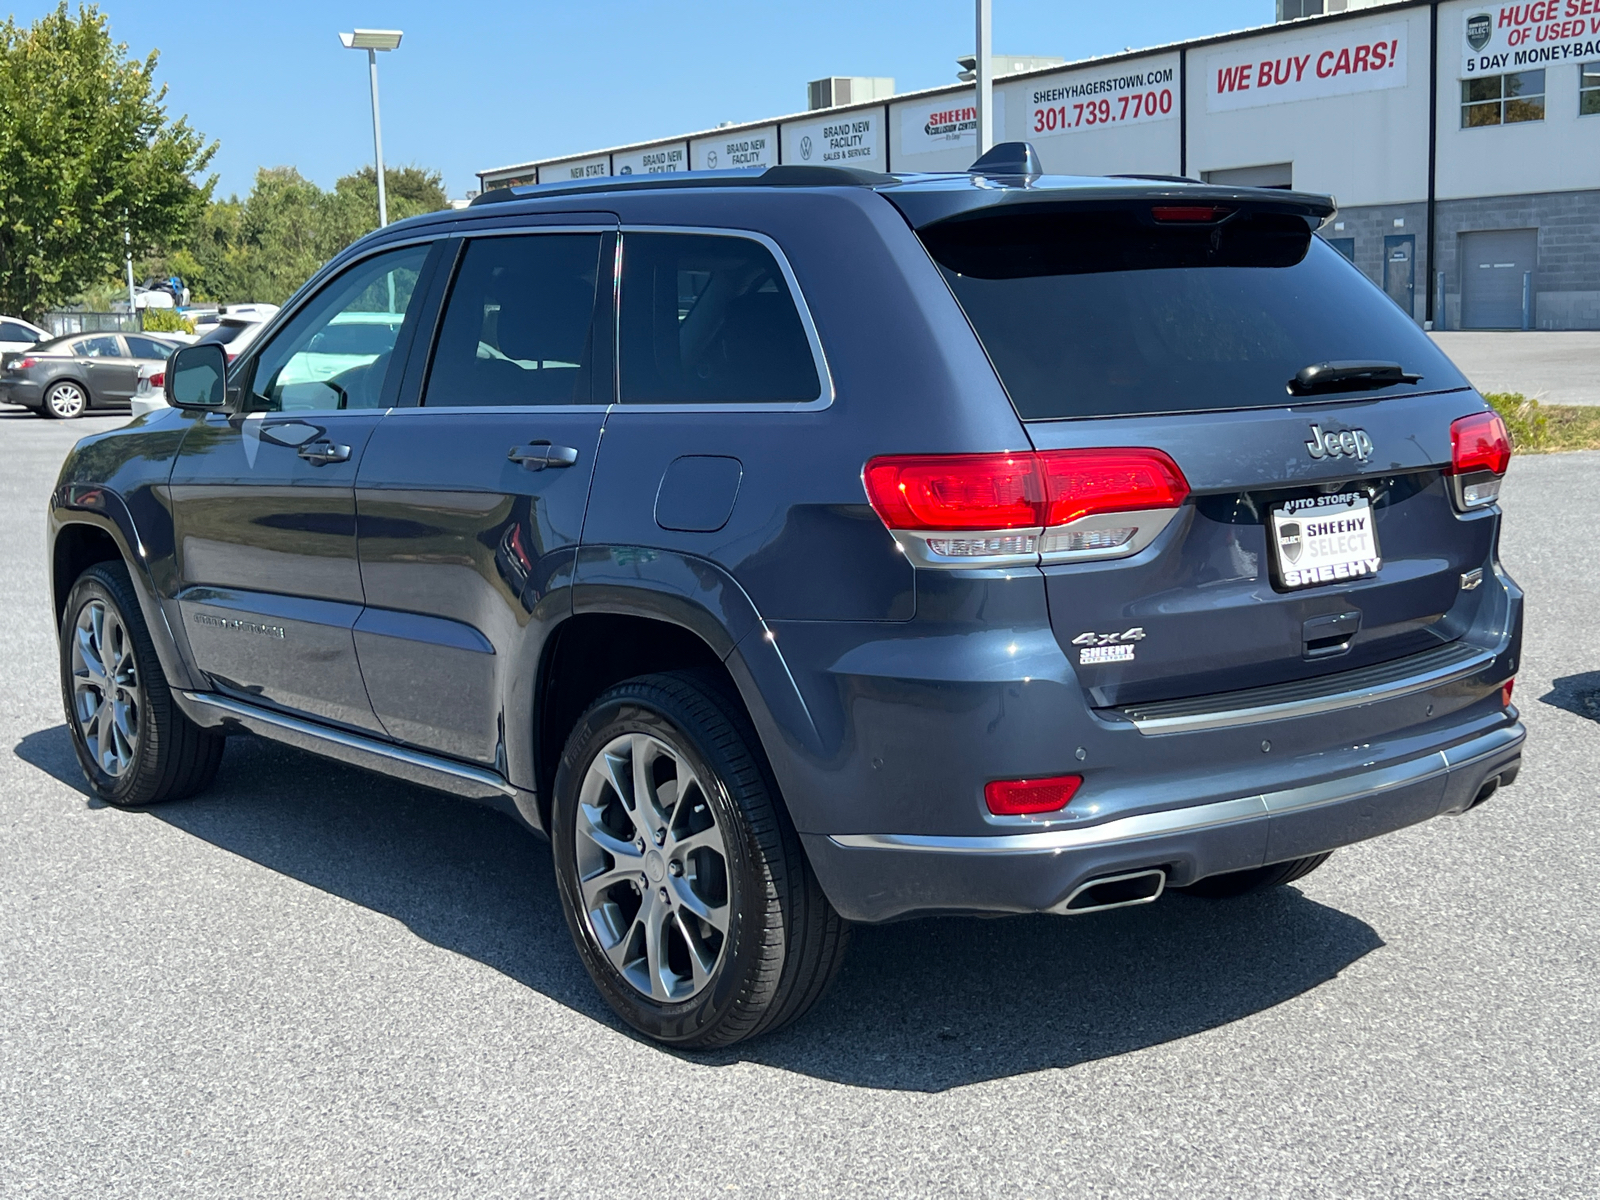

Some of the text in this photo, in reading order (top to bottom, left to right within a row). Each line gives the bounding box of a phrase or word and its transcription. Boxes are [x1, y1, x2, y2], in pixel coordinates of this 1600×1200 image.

[1498, 0, 1559, 29] HUGE
[1508, 27, 1531, 47] OF
[1535, 19, 1585, 42] USED
[1217, 39, 1398, 94] WE BUY CARS!
[1467, 58, 1475, 72] 5
[1480, 53, 1509, 70] DAY
[1033, 68, 1173, 104] SHEEHYHAGERSTOWN.COM
[1033, 88, 1172, 133] 301.739.7700
[823, 120, 870, 139] BRAND NEW
[931, 124, 957, 136] COLLISION
[726, 139, 766, 155] BRAND NEW
[830, 134, 863, 150] FACILITY
[643, 149, 682, 167] BRAND NEW
[732, 151, 760, 165] FACILITY
[823, 147, 871, 162] SALES & SERVICE
[571, 163, 605, 179] NEW STATE
[1304, 424, 1373, 462] Jeep
[1283, 498, 1314, 511] AUTO
[1307, 517, 1365, 537] SHEEHY
[1309, 532, 1368, 558] SELECT
[1284, 557, 1381, 587] SHEEHY
[1080, 644, 1135, 658] SHEEHY
